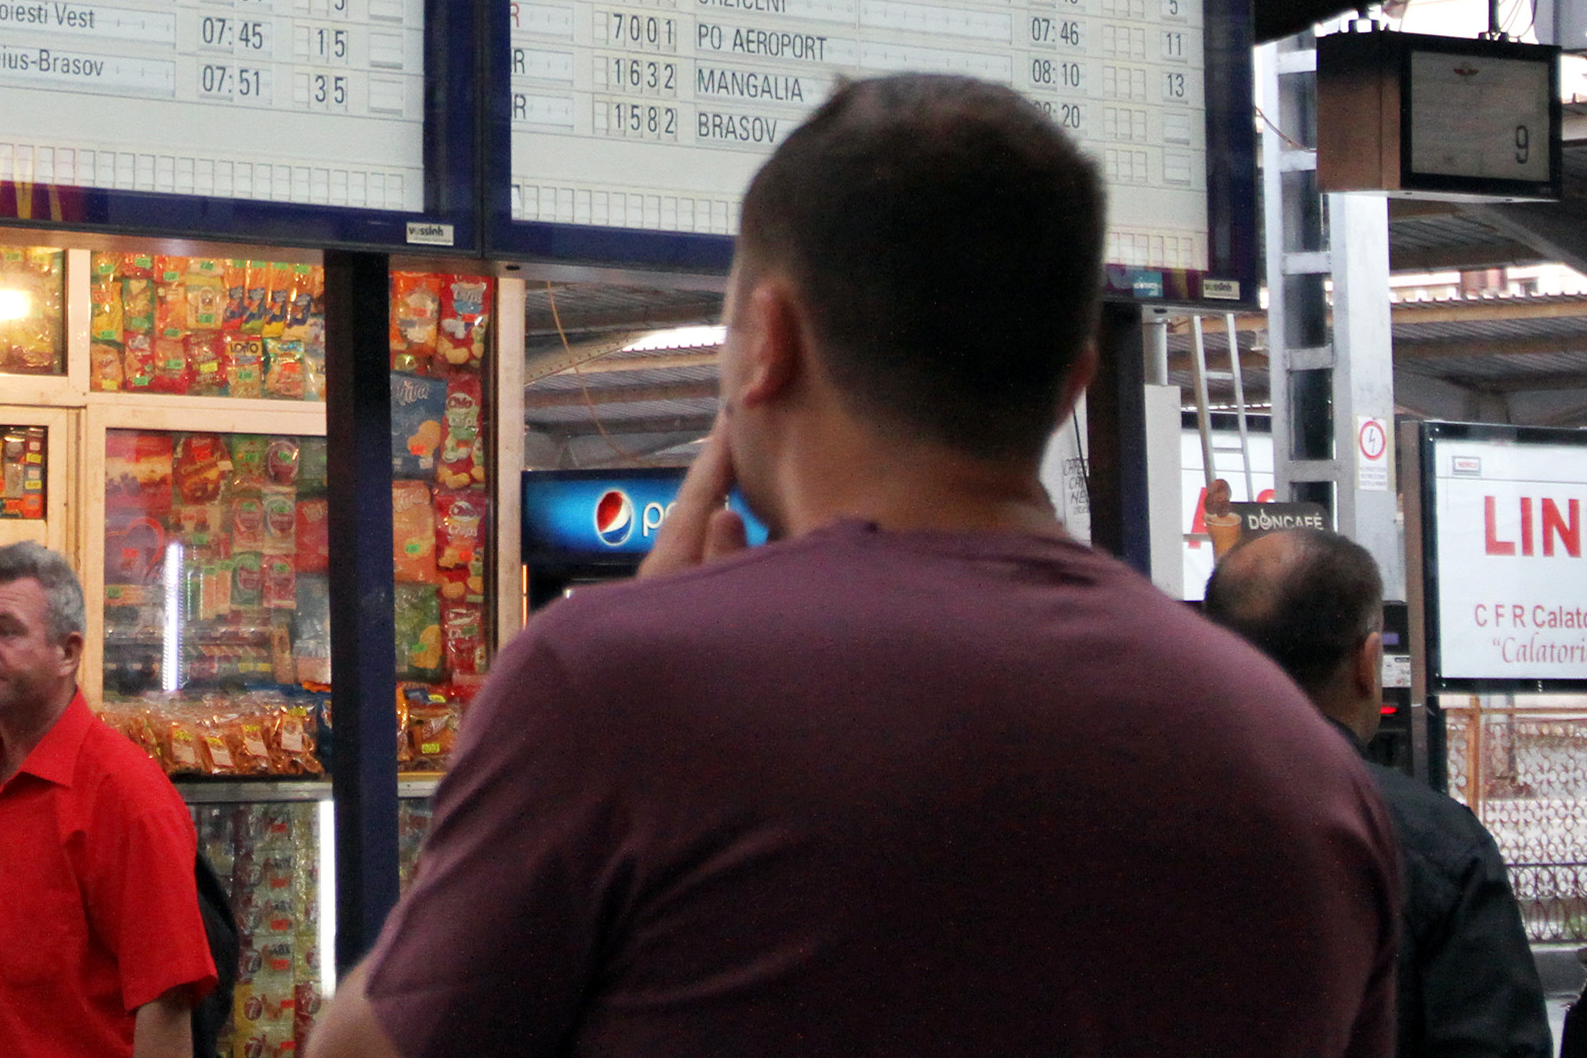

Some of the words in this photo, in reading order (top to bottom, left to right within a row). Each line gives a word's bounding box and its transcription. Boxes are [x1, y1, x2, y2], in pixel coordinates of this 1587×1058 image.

[55, 3, 95, 29] Vest
[317, 30, 345, 57] 15
[1166, 32, 1182, 56] 11
[613, 14, 673, 45] 7001
[732, 29, 827, 62] AEROPORT
[1167, 74, 1184, 98] 13
[315, 76, 345, 104] 35
[615, 58, 675, 90] 1632
[698, 68, 803, 103] MANGALIA
[615, 103, 675, 134] 1582
[698, 113, 777, 143] BRASOV
[1484, 495, 1587, 558] LIN
[1492, 632, 1587, 664] “Calatori
